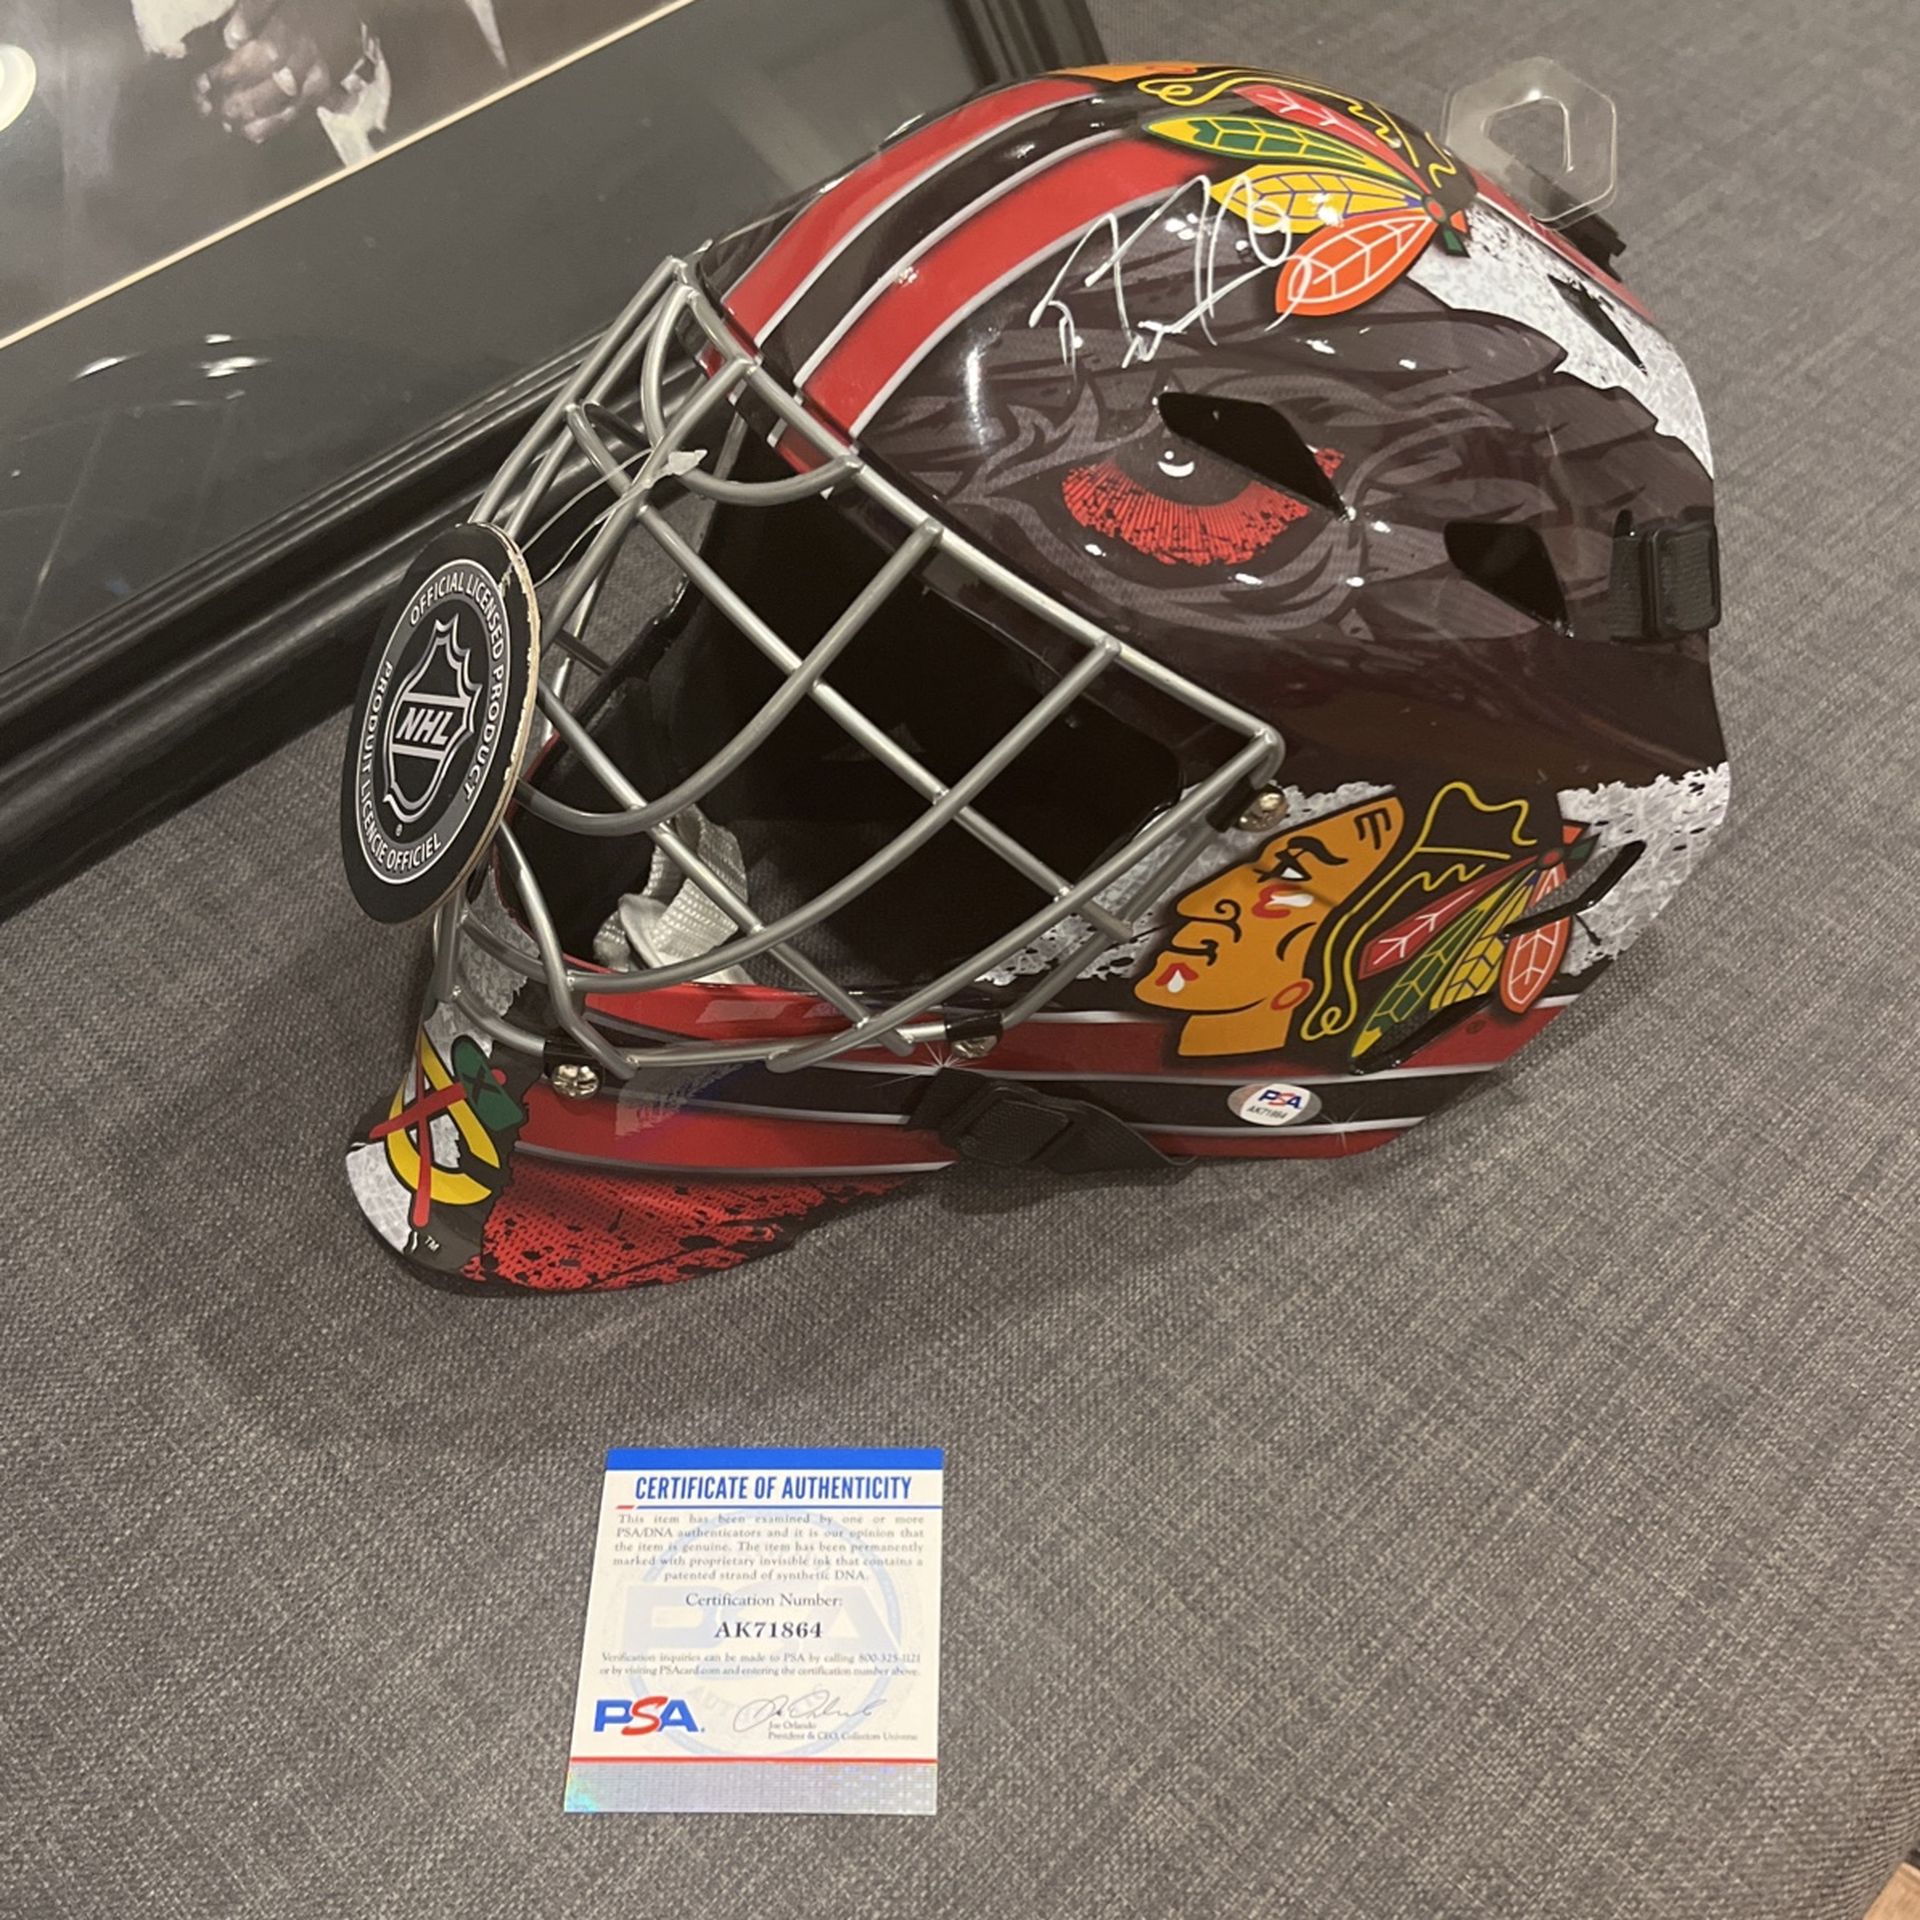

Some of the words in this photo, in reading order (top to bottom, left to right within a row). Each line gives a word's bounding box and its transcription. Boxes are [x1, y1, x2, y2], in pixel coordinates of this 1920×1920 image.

[410, 571, 464, 625] OFFICIAL
[465, 574, 504, 661] LICENSED
[395, 706, 455, 746] NHL
[464, 664, 506, 801] PRODUCT
[361, 660, 393, 775] PRODUIT
[385, 832, 442, 871] OFFICIEL
[1258, 1089, 1302, 1109] PSA
[635, 1476, 749, 1500] CERTIFICATE
[754, 1476, 777, 1500] OF
[782, 1476, 912, 1500] AUTHENTICITY
[617, 1513, 644, 1524] This
[653, 1513, 680, 1524] item
[689, 1513, 708, 1524] has
[718, 1513, 745, 1524] been
[754, 1513, 810, 1524] examined
[819, 1513, 834, 1526] by
[842, 1513, 864, 1524] one
[872, 1513, 886, 1524] or
[895, 1513, 924, 1524] more
[616, 1527, 673, 1538] PSA/DNA
[678, 1527, 761, 1538] authenticators
[766, 1527, 789, 1538] and
[794, 1527, 803, 1538] it
[809, 1527, 818, 1538] is
[824, 1527, 843, 1538] our
[849, 1527, 895, 1540] opinion
[900, 1527, 924, 1538] that
[614, 1541, 633, 1552] the
[638, 1541, 664, 1552] item
[668, 1541, 678, 1552] is
[682, 1541, 732, 1554] genuine.
[737, 1541, 760, 1552] The
[764, 1541, 790, 1552] item
[795, 1541, 814, 1552] has
[819, 1541, 846, 1552] been
[850, 1541, 924, 1554] permanently
[612, 1555, 656, 1566] marked
[660, 1555, 686, 1566] with
[689, 1555, 755, 1568] proprietary
[759, 1555, 809, 1566] invisible
[813, 1555, 831, 1566] ink
[835, 1555, 859, 1566] that
[862, 1555, 913, 1566] contains
[916, 1555, 924, 1566] a
[664, 1569, 716, 1582] patented
[719, 1569, 757, 1580] strand
[761, 1569, 775, 1580] of
[776, 1569, 829, 1582] synthetic
[834, 1569, 868, 1580] DNA.
[685, 1593, 774, 1607] Certification
[779, 1593, 843, 1607] Number:
[714, 1621, 823, 1639] AK71864
[593, 1696, 699, 1735] PSA
